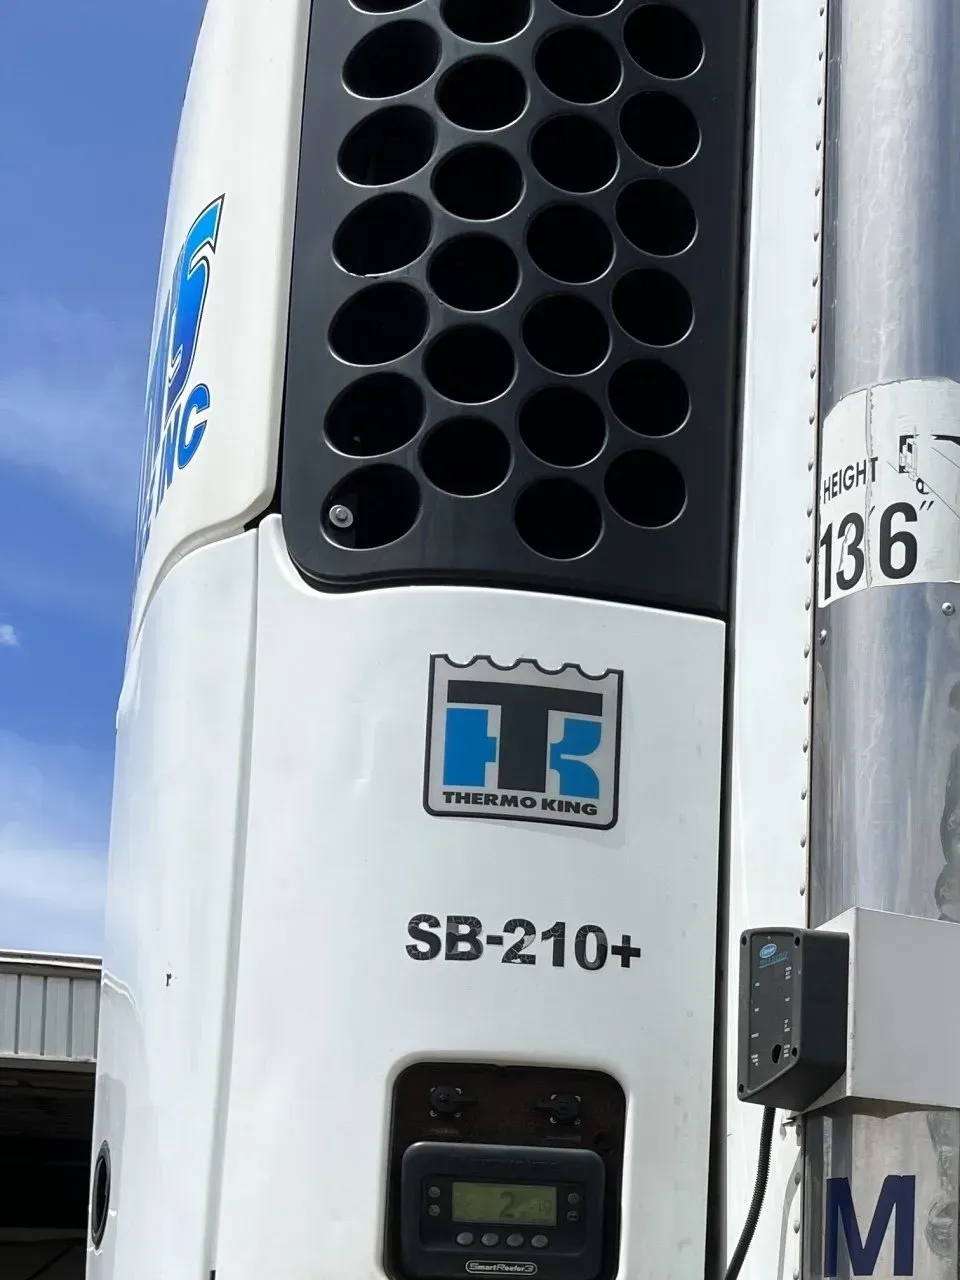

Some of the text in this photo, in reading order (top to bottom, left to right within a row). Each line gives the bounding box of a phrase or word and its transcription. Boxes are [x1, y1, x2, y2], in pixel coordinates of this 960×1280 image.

[822, 456, 879, 504] HEIGHT
[442, 790, 599, 816] THERMO KING
[405, 912, 642, 971] SB-210+
